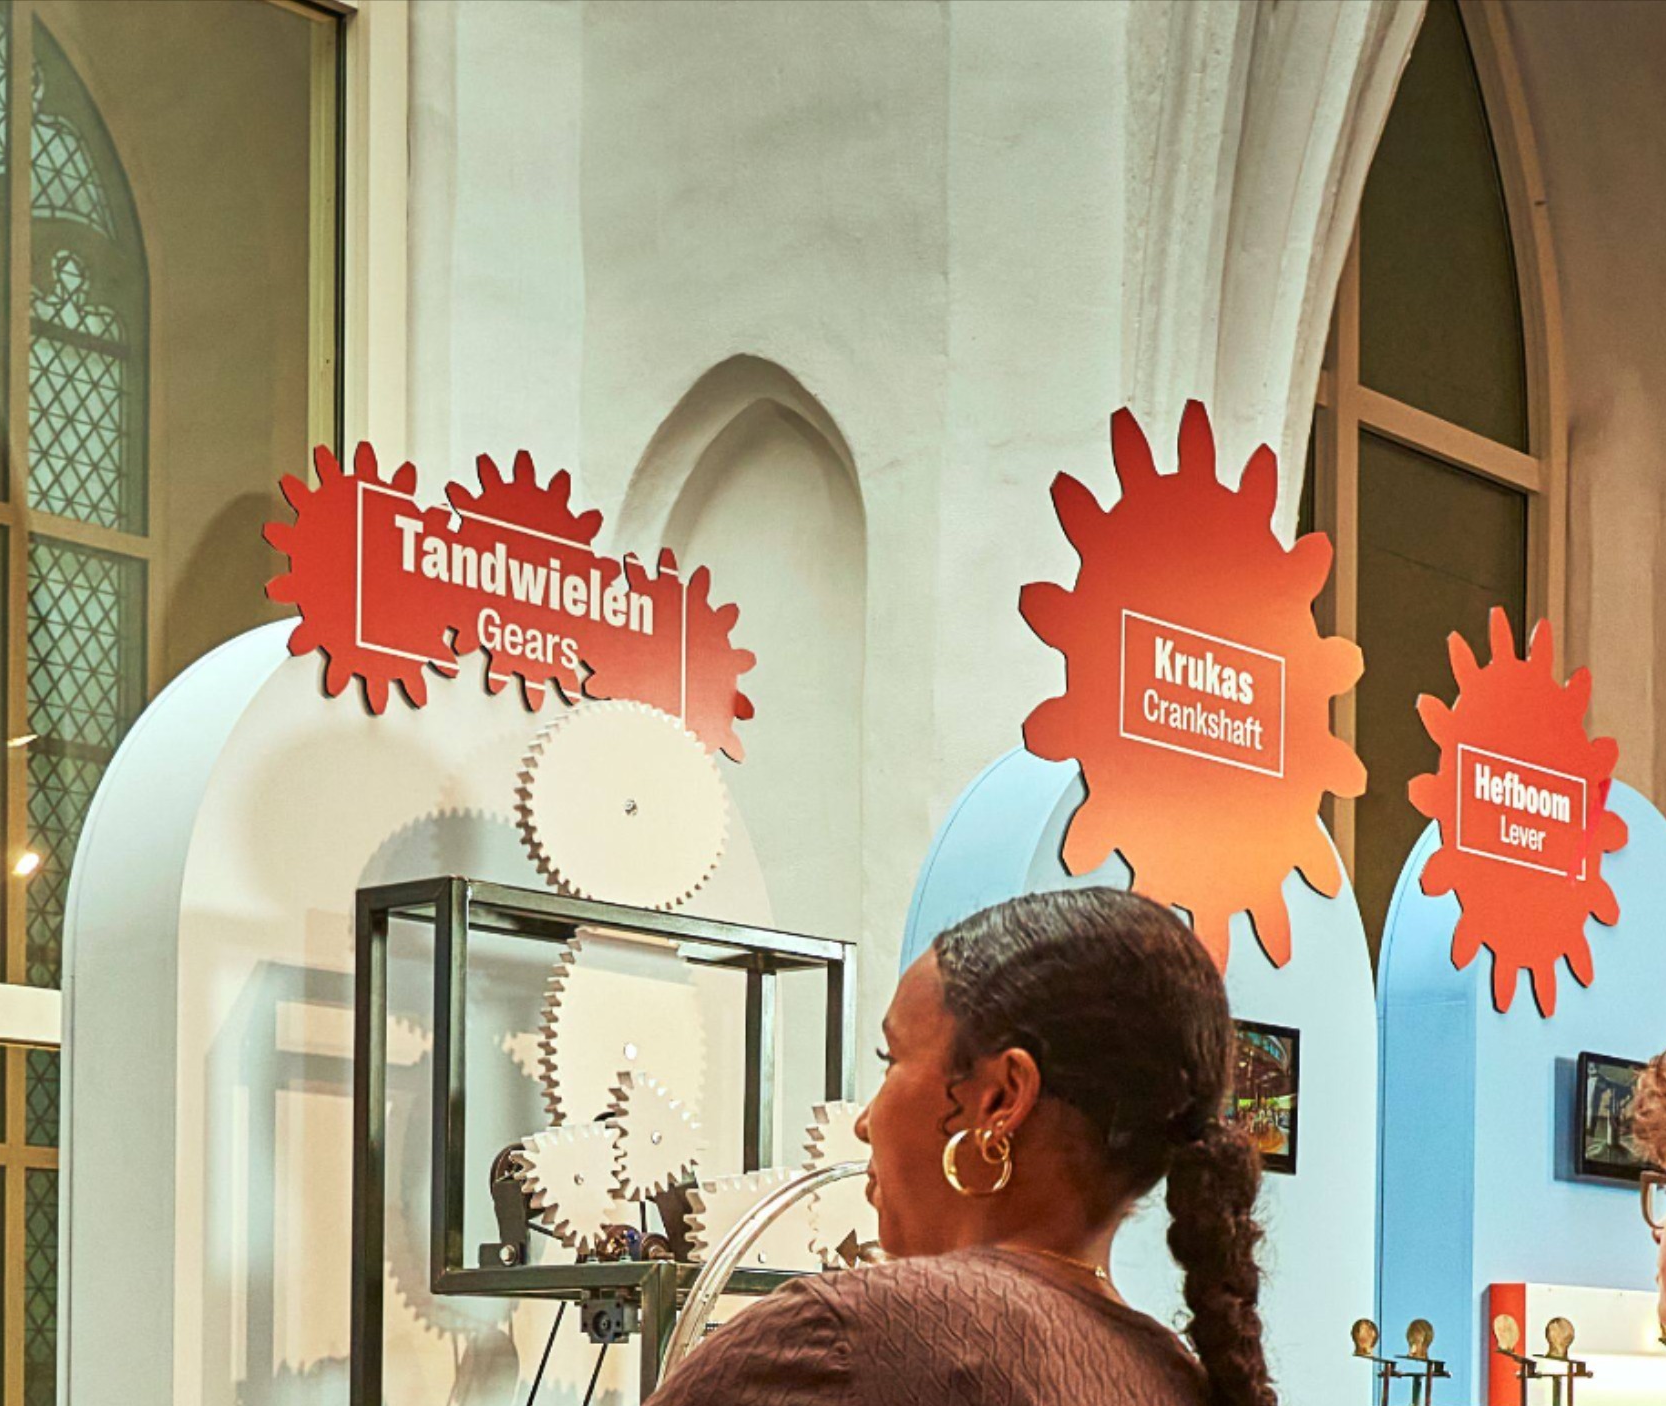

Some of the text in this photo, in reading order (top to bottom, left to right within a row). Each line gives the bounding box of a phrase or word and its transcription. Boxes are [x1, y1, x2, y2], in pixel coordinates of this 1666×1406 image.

[394, 514, 654, 635] Tandwielen
[477, 607, 579, 669] Gears
[1154, 636, 1254, 705] Krukas
[1143, 688, 1263, 750] Crankshaft
[1475, 762, 1570, 823] Hefboom
[1500, 814, 1546, 852] Lever
